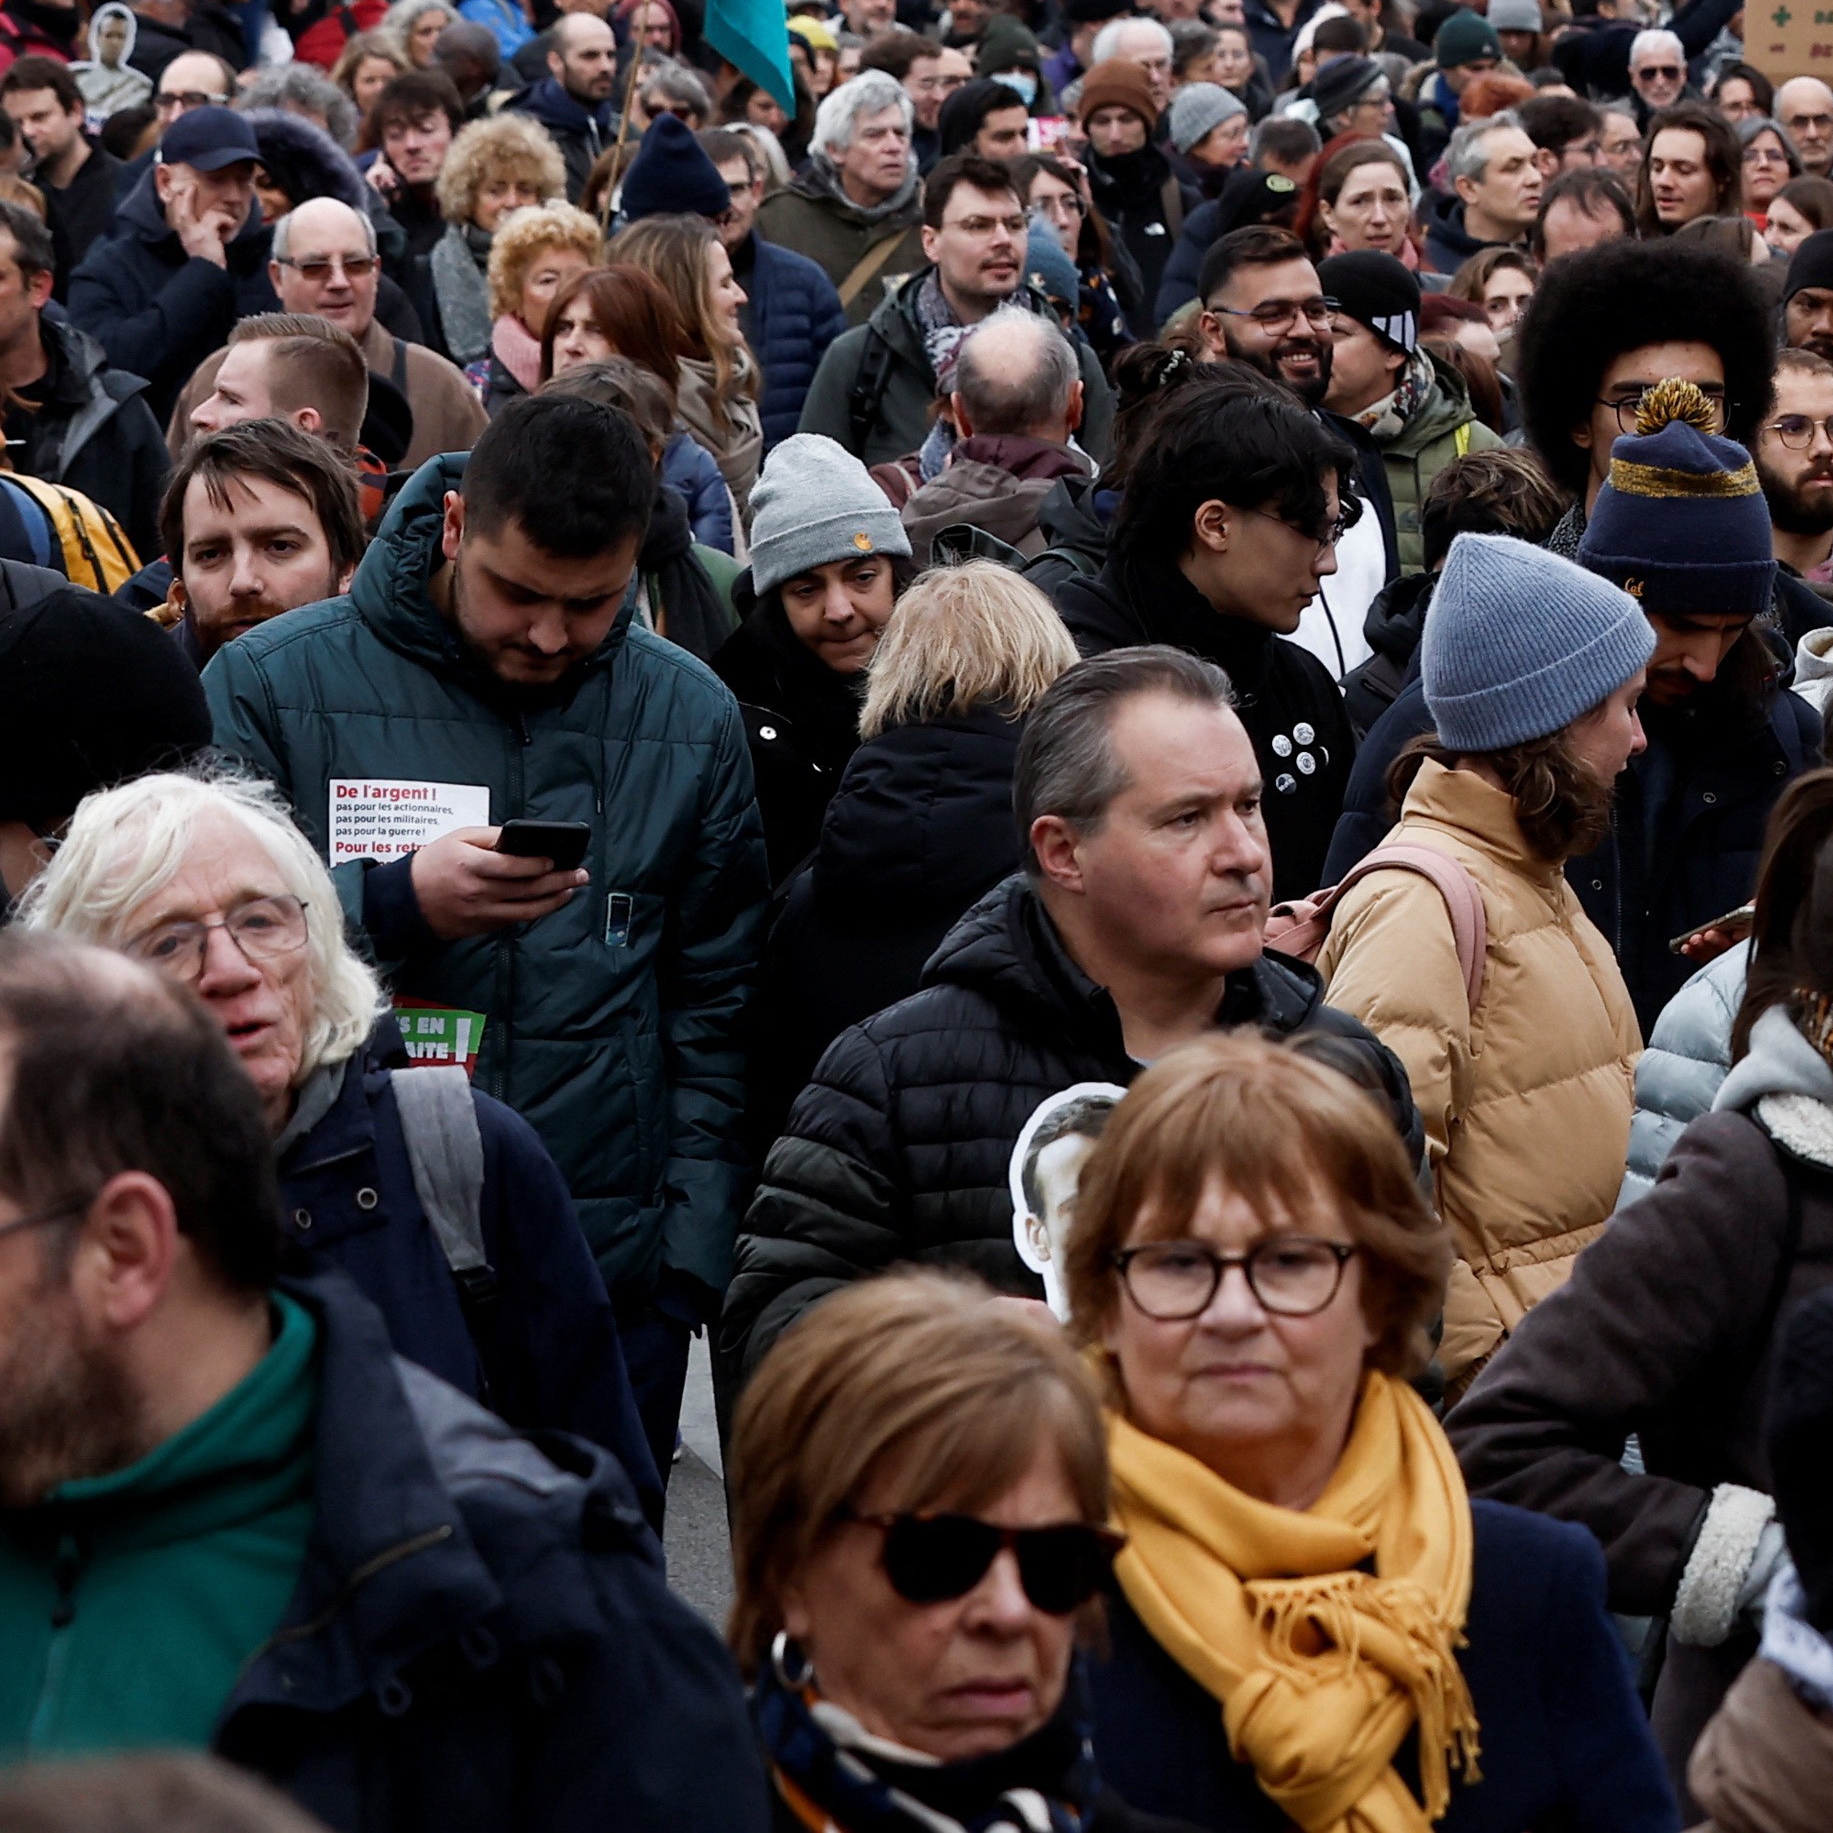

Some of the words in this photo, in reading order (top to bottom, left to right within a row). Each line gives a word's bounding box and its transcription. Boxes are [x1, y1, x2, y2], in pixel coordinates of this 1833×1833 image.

[1624, 576, 1645, 597] Cal
[336, 785, 358, 799] De
[363, 784, 429, 802] l'argent
[432, 788, 437, 801] !
[336, 803, 351, 813] pas
[354, 803, 376, 813] pour
[378, 802, 392, 812] les
[393, 803, 454, 816] actionnaires,
[336, 816, 351, 826] pas
[354, 815, 376, 826] pour
[378, 815, 392, 824] les
[336, 828, 351, 837] pas
[354, 828, 376, 837] pour
[378, 827, 387, 836] la
[388, 828, 421, 838] guerre
[336, 841, 368, 853] Pour
[372, 841, 392, 853] les
[397, 1016, 411, 1033] S
[417, 1017, 445, 1035] EN
[455, 1018, 472, 1063] !
